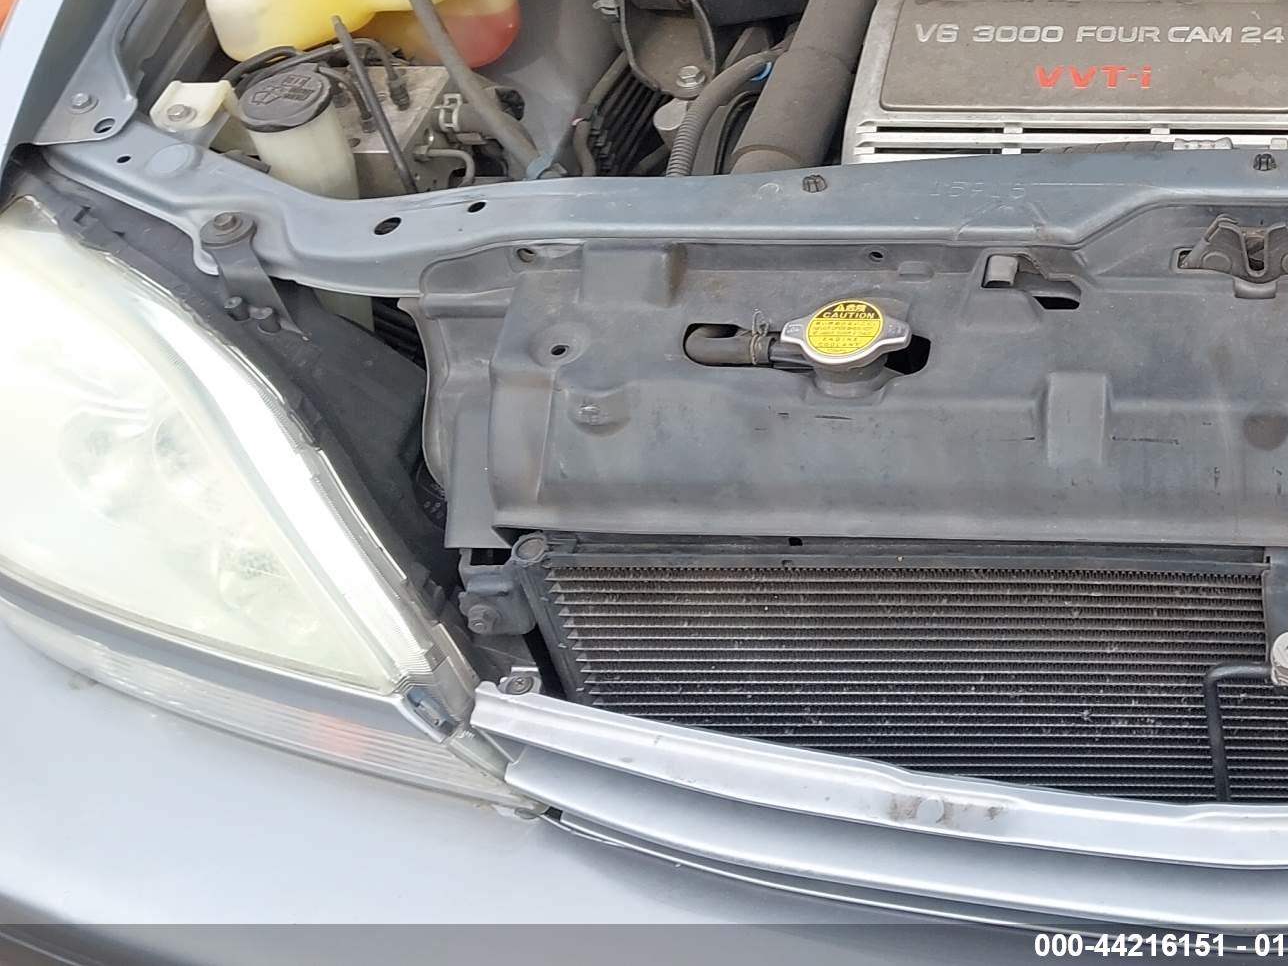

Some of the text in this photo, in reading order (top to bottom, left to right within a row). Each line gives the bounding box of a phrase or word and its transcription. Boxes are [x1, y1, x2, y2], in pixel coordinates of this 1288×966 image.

[915, 23, 1285, 43] V6 3000 FOUR CAM 24
[1035, 65, 1154, 90] VVT-i
